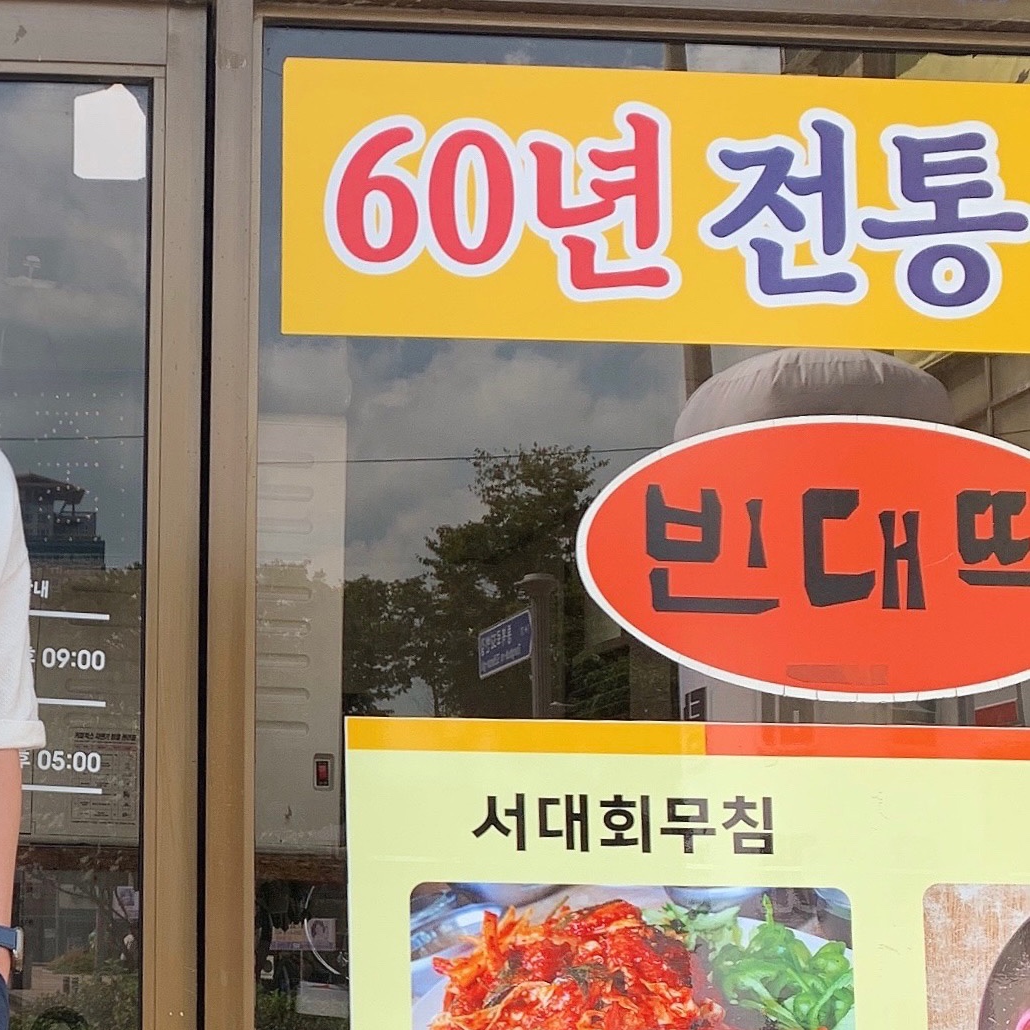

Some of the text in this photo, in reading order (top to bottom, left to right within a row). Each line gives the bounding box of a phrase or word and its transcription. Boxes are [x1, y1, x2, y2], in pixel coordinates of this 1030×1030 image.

[336, 112, 1029, 307] 60년 전통
[30, 580, 49, 599] 내
[42, 647, 106, 671] 09:00
[37, 750, 102, 773] 05:00
[472, 793, 775, 855] 서대회무침
